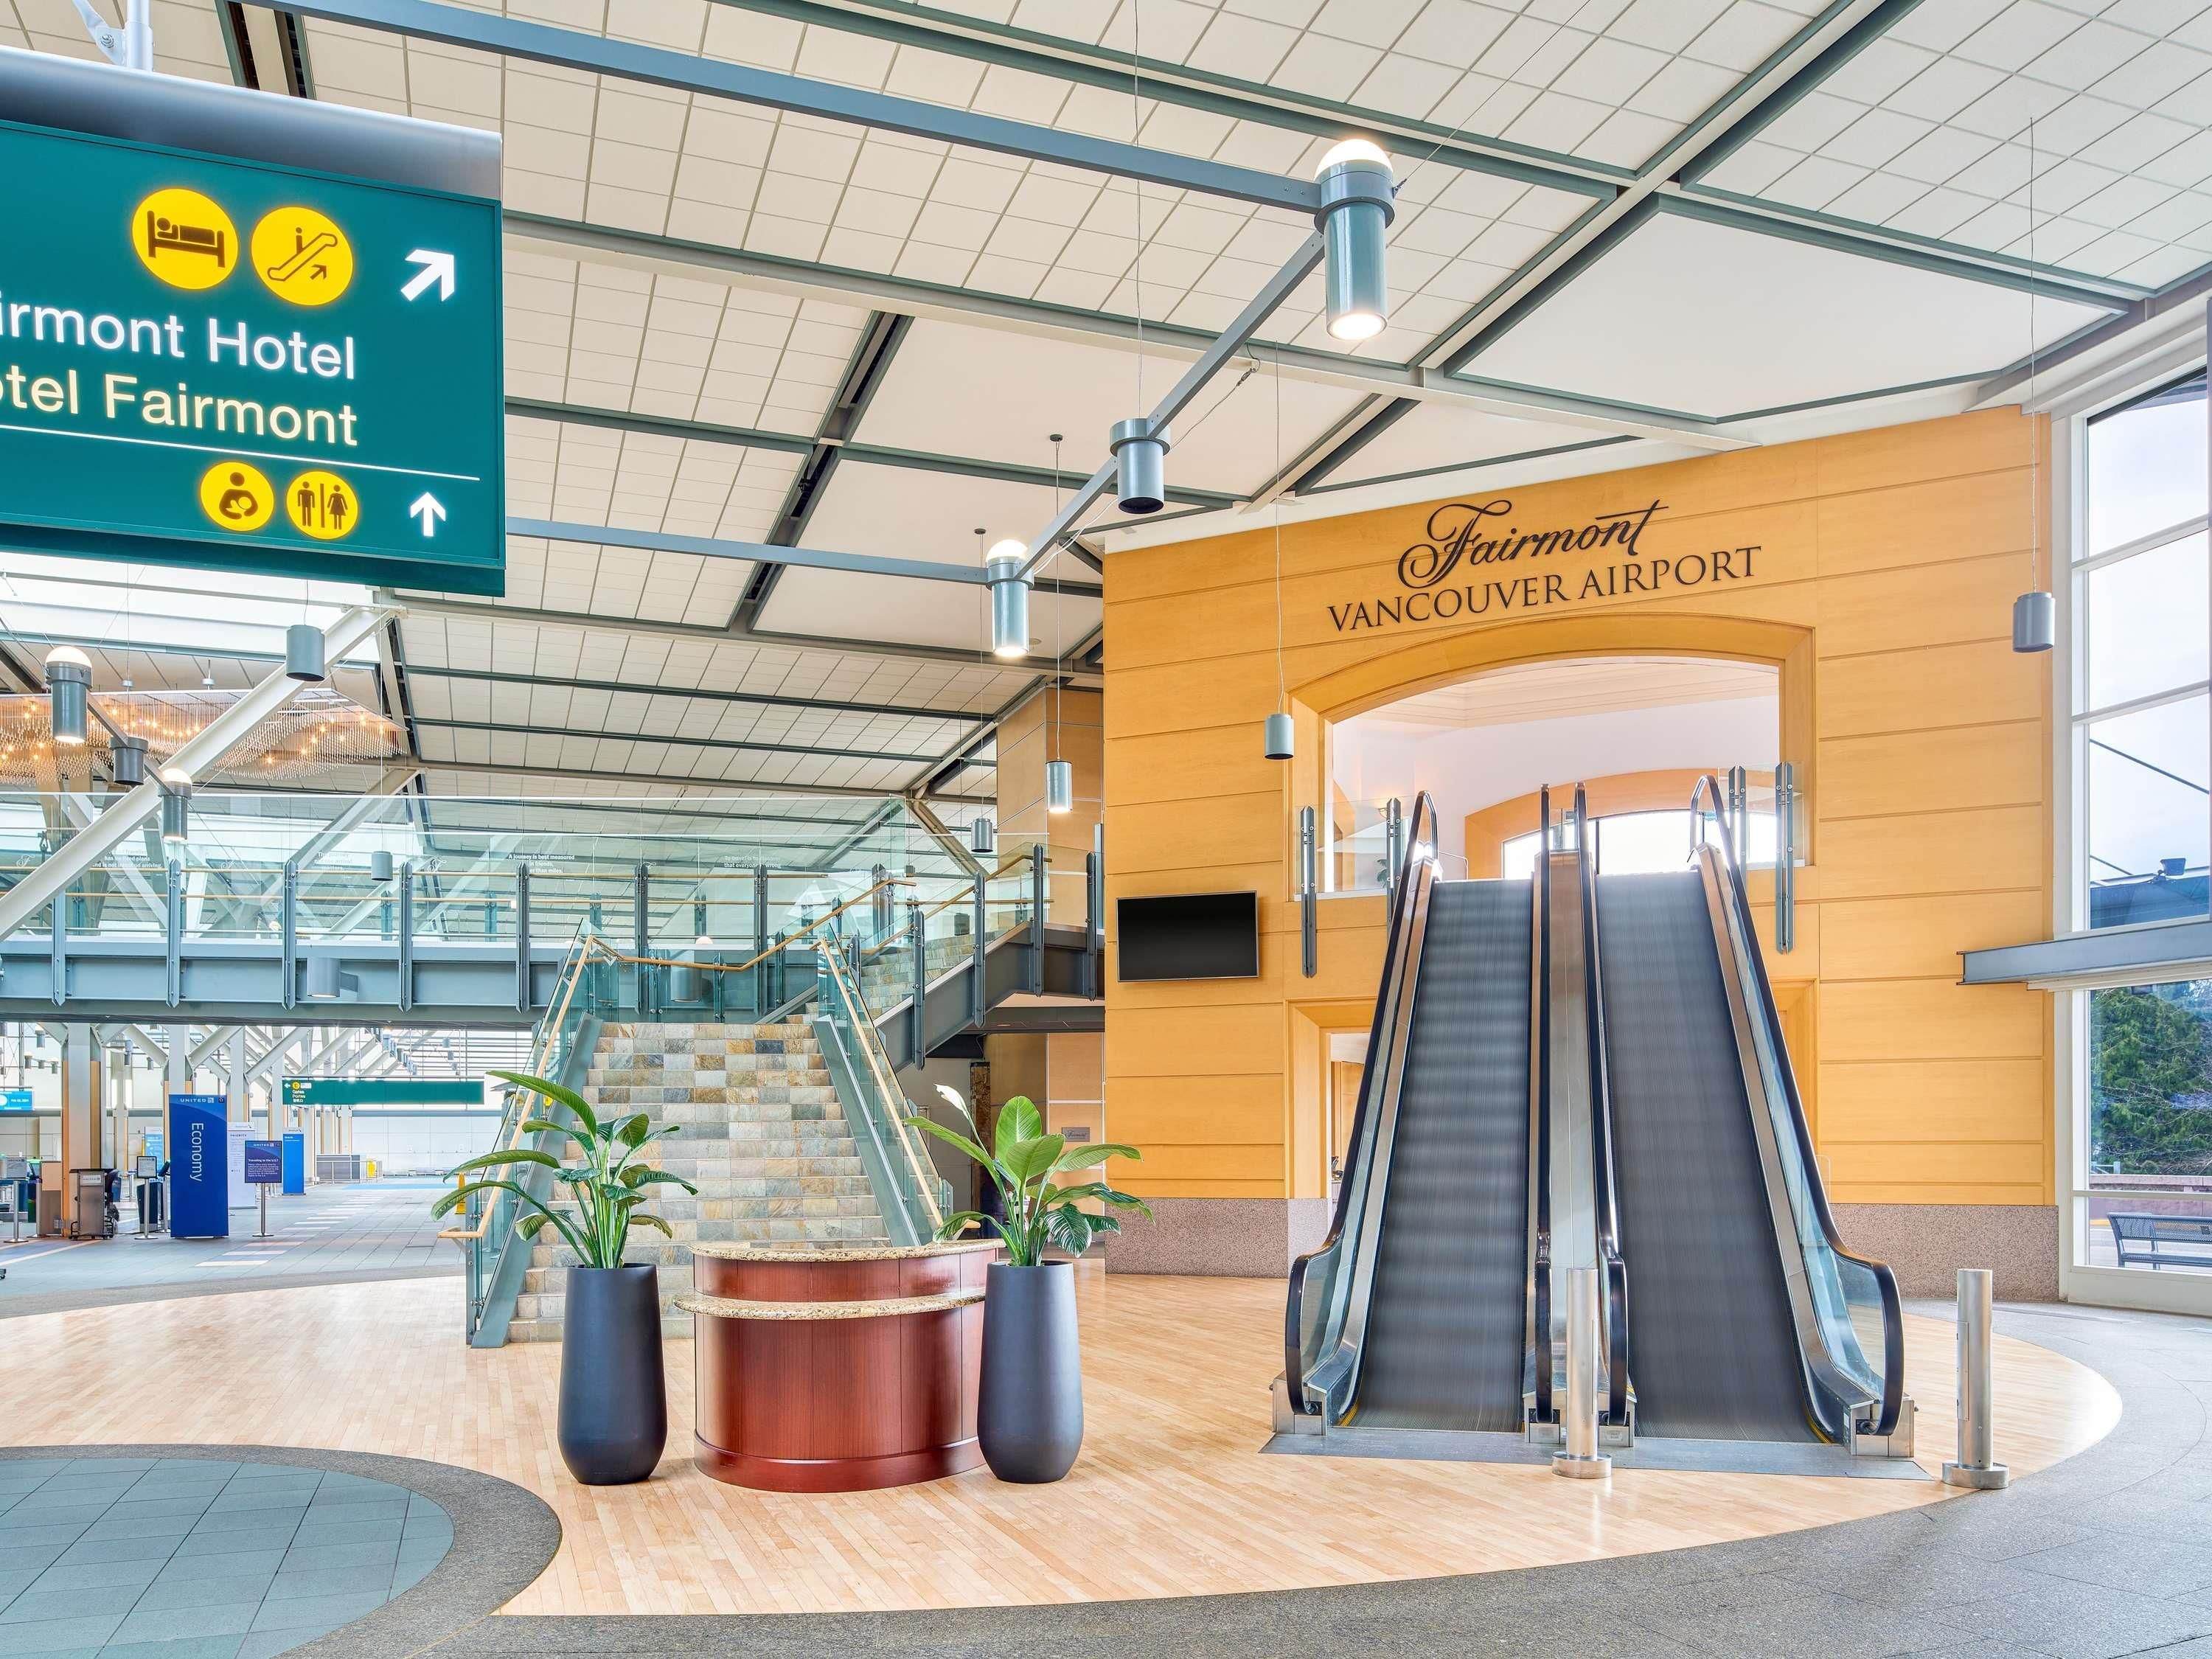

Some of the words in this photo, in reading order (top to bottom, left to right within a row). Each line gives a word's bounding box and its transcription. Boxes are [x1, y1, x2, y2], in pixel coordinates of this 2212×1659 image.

[209, 319, 355, 380] Hotel
[0, 365, 79, 415] tel
[105, 374, 358, 446] Fairmont
[1398, 499, 1669, 589] Fairmont
[1327, 574, 1571, 632] VANCOUVER
[1578, 546, 1761, 599] AIRPORT
[189, 1123, 204, 1182] Economy
